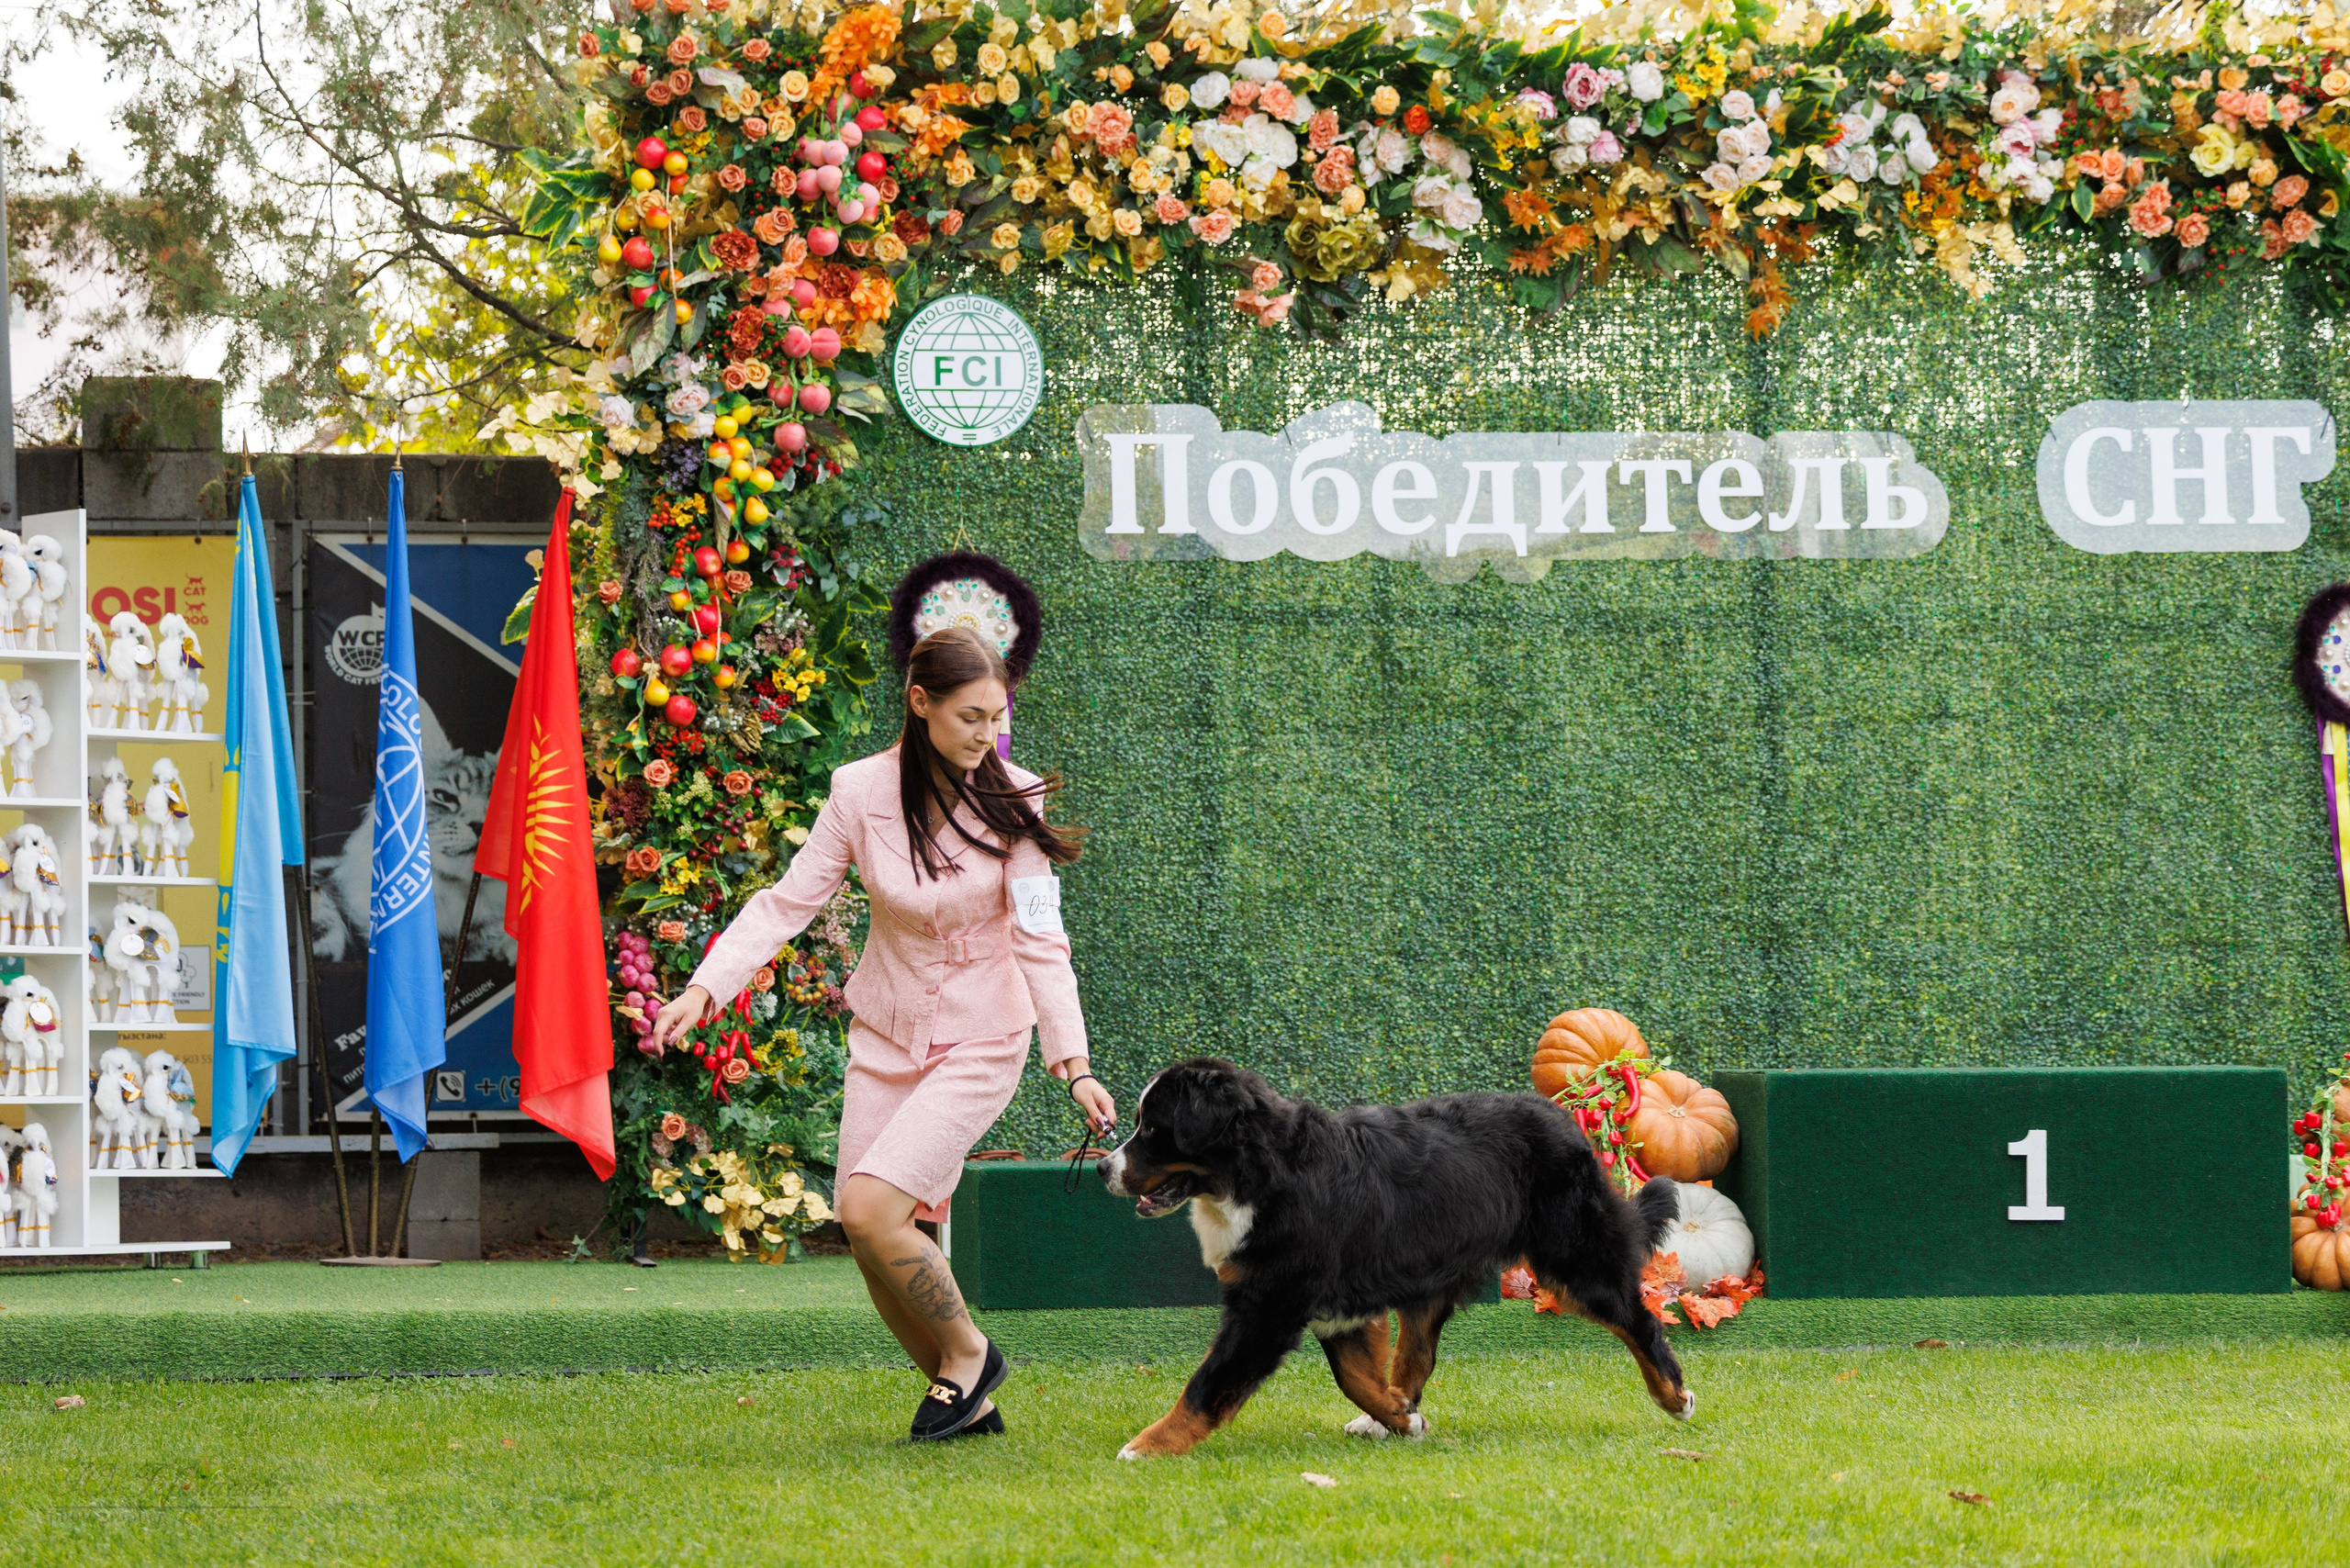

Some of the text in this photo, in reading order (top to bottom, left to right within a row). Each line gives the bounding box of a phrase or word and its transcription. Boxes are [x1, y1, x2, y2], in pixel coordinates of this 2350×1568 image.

[897, 298, 1039, 438] FEDERATION CYNOLOGIQUE INTERNATIONALE
[934, 356, 1002, 386] FCI
[1102, 427, 2312, 557] Победитель СНГ
[86, 586, 176, 625] OSI
[184, 587, 207, 596] CAT
[461, 979, 496, 1007] кошек
[2008, 1129, 2065, 1221] 1
